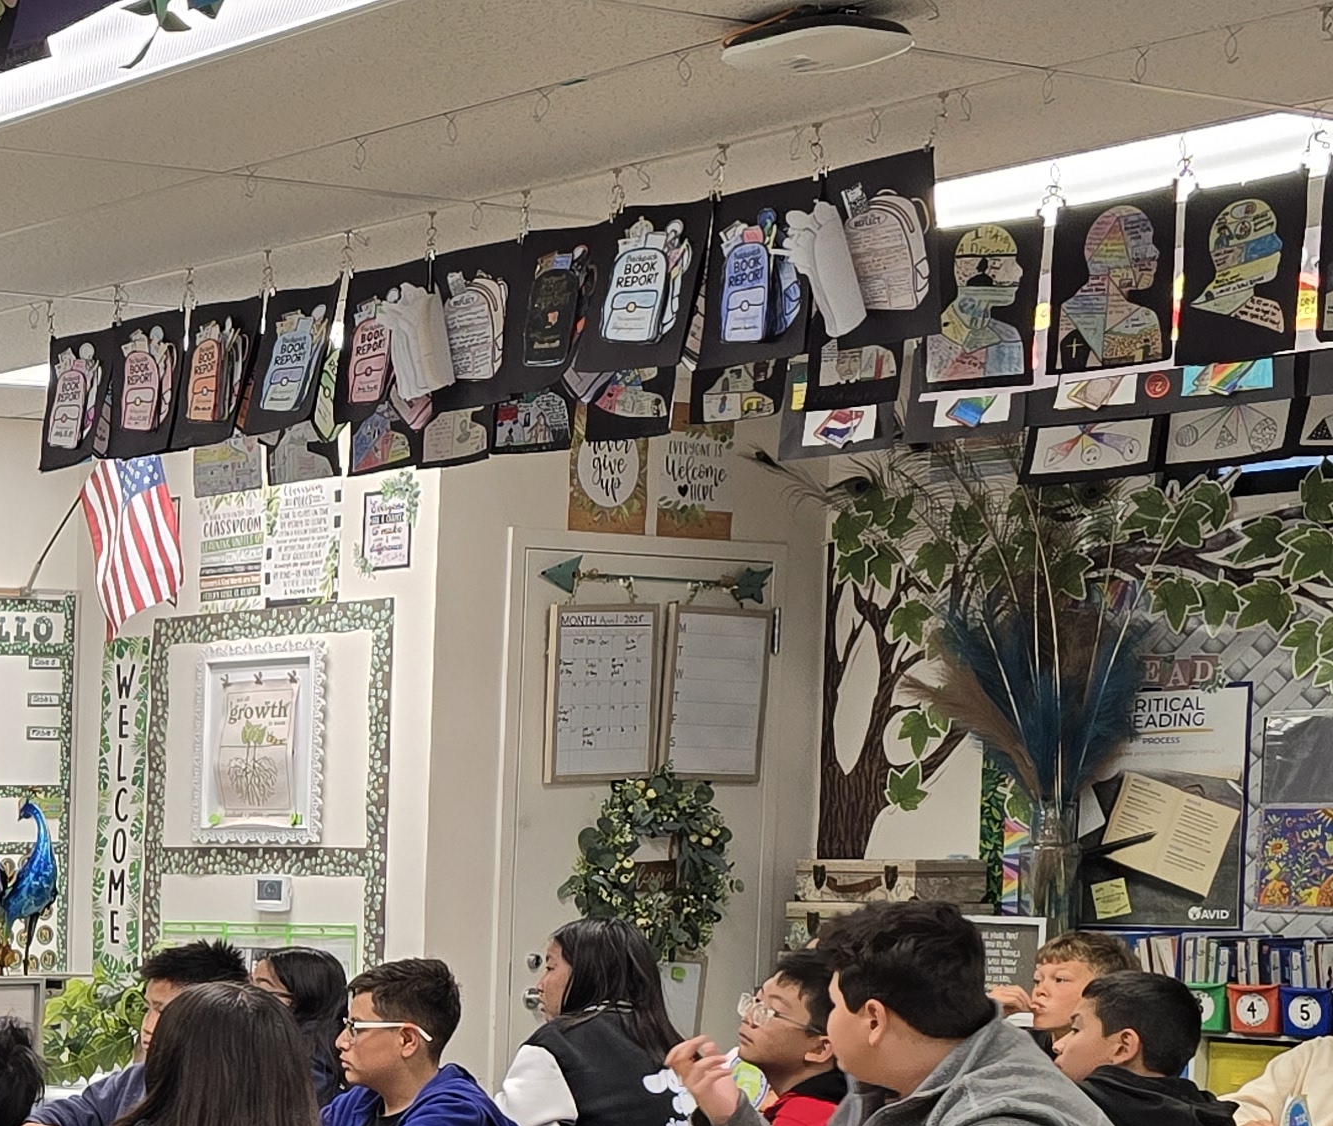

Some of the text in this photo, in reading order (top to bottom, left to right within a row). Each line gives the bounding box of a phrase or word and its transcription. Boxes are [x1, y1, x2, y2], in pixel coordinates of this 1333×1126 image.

[623, 262, 656, 275] BOOK
[733, 258, 762, 272] BOOK
[615, 273, 658, 288] REPORT
[728, 269, 764, 288] REPORT
[280, 341, 306, 355] BOOK
[198, 351, 215, 364] BOOK
[274, 351, 307, 365] REPORT
[129, 362, 150, 375] BOOK
[127, 372, 153, 386] REPORT
[61, 381, 81, 393] BOOK
[668, 440, 711, 456] EVERYONE
[592, 454, 628, 486] give
[665, 454, 727, 486] Welcome
[600, 476, 622, 502] up
[203, 515, 262, 538] CLASSROOM
[561, 615, 597, 626] MONTH
[228, 700, 292, 724] growth
[1134, 696, 1206, 713] RITICAL
[1142, 736, 1181, 745] PROCESS
[107, 663, 136, 944] WELCOME
[1200, 909, 1230, 920] AVID
[1246, 1001, 1258, 1018] 4
[1300, 1003, 1311, 1021] 5
